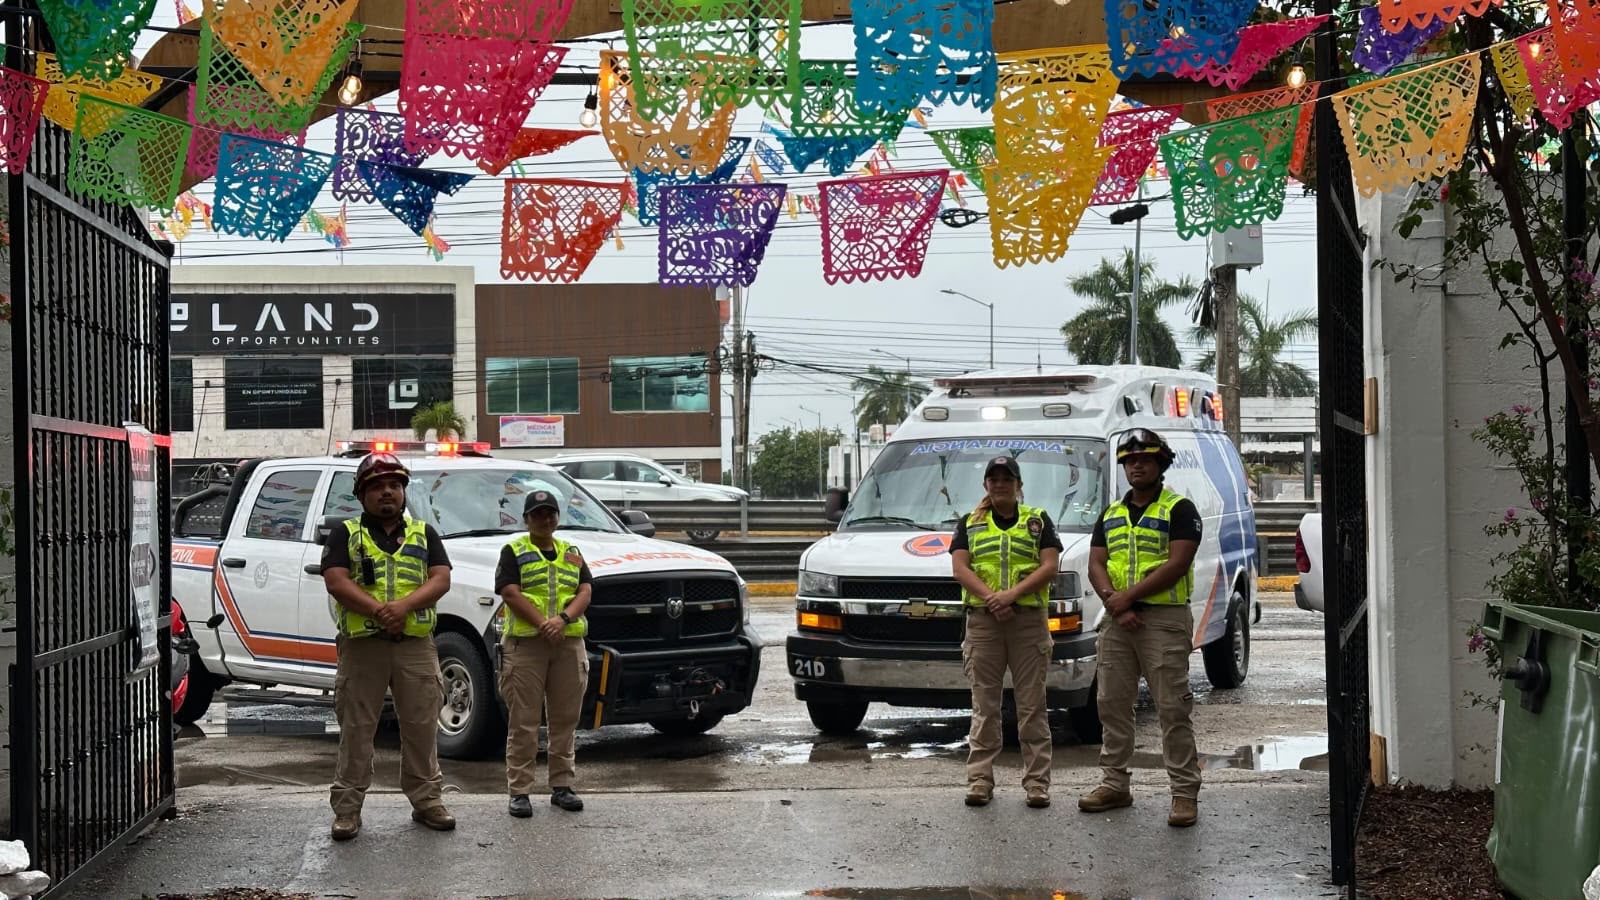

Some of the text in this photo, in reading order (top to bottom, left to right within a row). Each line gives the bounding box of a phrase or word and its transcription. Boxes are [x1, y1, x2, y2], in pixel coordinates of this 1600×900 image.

[211, 303, 379, 332] LAND
[212, 336, 380, 345] OPPORTUNITIES
[795, 659, 825, 676] 21D
